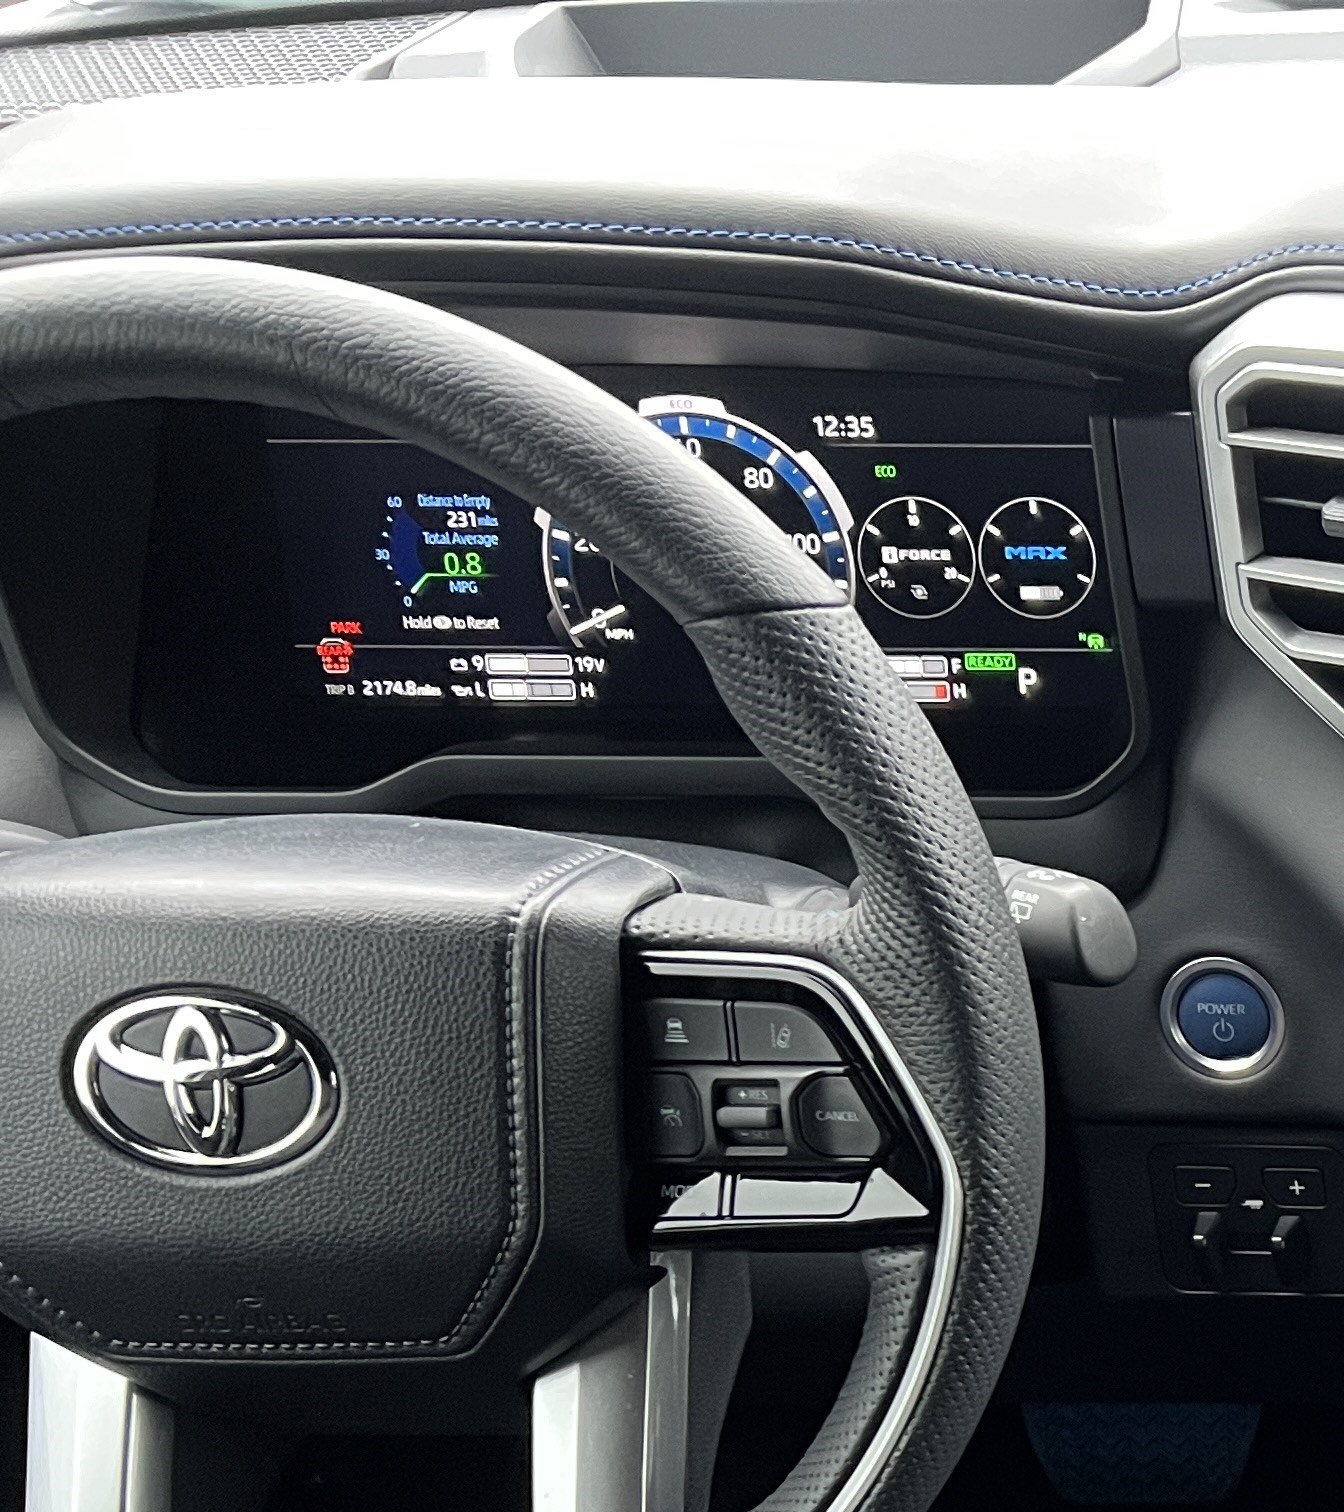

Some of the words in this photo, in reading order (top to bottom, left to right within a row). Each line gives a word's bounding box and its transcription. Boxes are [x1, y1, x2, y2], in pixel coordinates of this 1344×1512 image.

[812, 415, 875, 438] 12:35
[743, 467, 774, 489] 80
[874, 465, 896, 478] ECO
[387, 496, 402, 508] 60
[446, 511, 477, 528] 231
[422, 532, 450, 546] Total
[452, 532, 499, 548] Average
[375, 548, 390, 560] 30
[1004, 546, 1068, 560] MAX
[443, 552, 482, 575] 0.8
[449, 580, 478, 594] MPG
[330, 622, 362, 634] PARK
[402, 615, 433, 629] Hold
[453, 616, 466, 629] to
[466, 615, 500, 629] Reset
[604, 628, 634, 640] MPH
[471, 655, 484, 671] 9
[574, 656, 605, 673] 19V
[951, 657, 962, 674] F
[967, 656, 1012, 668] READY
[1018, 667, 1037, 695] P
[474, 681, 485, 698] L
[580, 682, 594, 698] H
[953, 682, 967, 699] H
[1197, 1002, 1246, 1016] POWER
